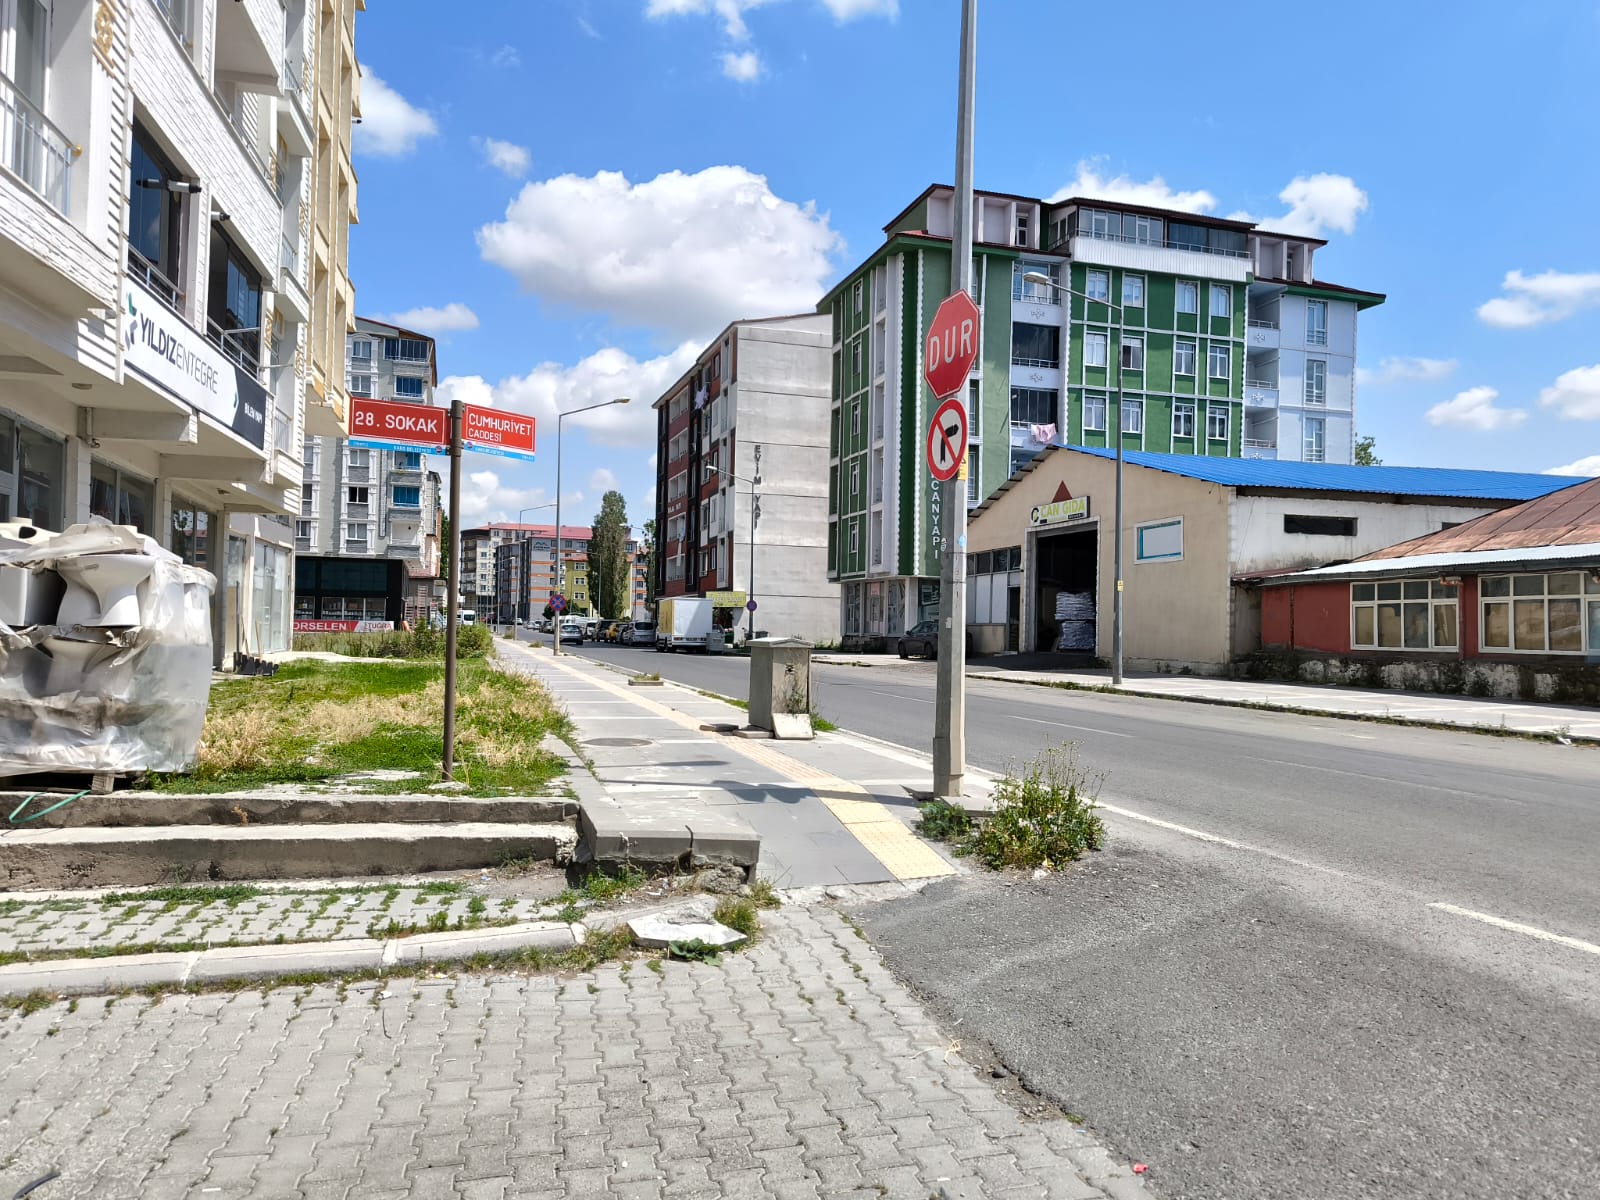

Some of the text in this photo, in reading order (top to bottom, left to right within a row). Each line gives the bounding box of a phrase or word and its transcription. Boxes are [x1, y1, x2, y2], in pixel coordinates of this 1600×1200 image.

[928, 318, 974, 374] DUR
[355, 411, 438, 433] 28. SOKAK
[468, 413, 532, 436] CUMHURİYET
[468, 427, 502, 442] CADDESİ
